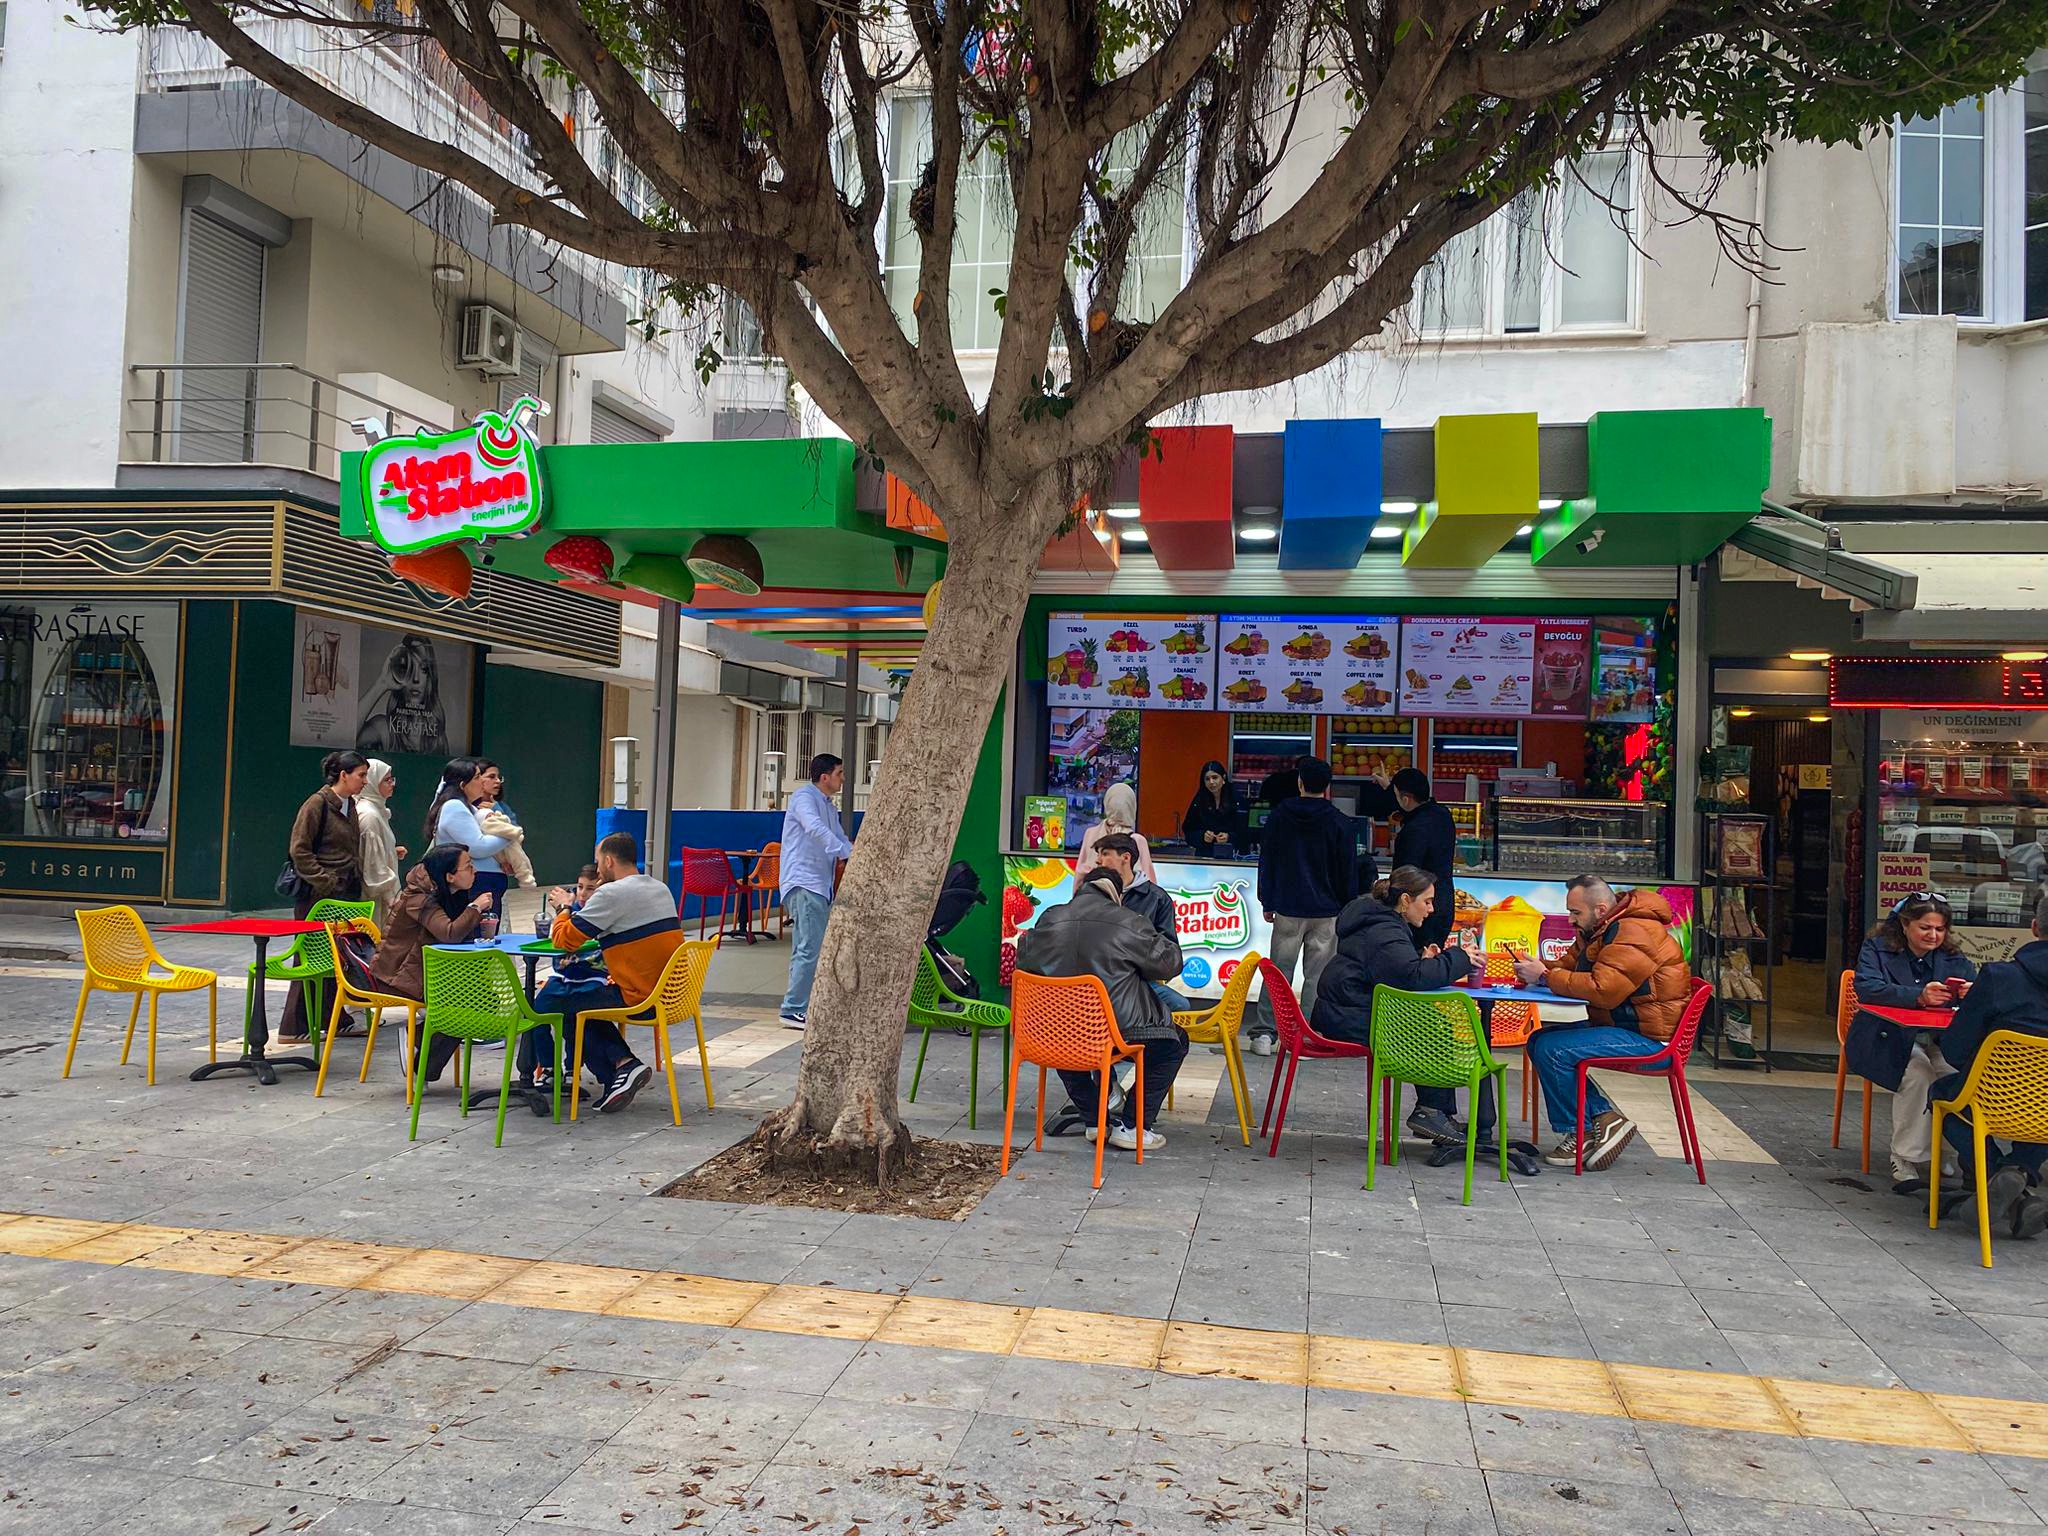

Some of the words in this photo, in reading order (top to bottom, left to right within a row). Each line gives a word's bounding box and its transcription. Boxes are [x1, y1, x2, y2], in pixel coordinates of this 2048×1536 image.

[384, 451, 472, 491] Atom
[407, 471, 526, 521] Station
[471, 504, 505, 522] Enerjini
[507, 501, 529, 516] Fulle
[1543, 631, 1582, 641] BEYOĞLU
[389, 715, 438, 737] KÉRASTASE
[1923, 716, 1942, 726] UN
[1944, 713, 2022, 727] DEĞİRMENİ
[1880, 854, 1900, 863] ÖZEL
[1902, 856, 1928, 864] YAPIM
[31, 859, 136, 879] tasarım
[1884, 865, 1923, 877] DANA
[1880, 881, 1928, 892] KASAP
[1172, 899, 1209, 917] tom
